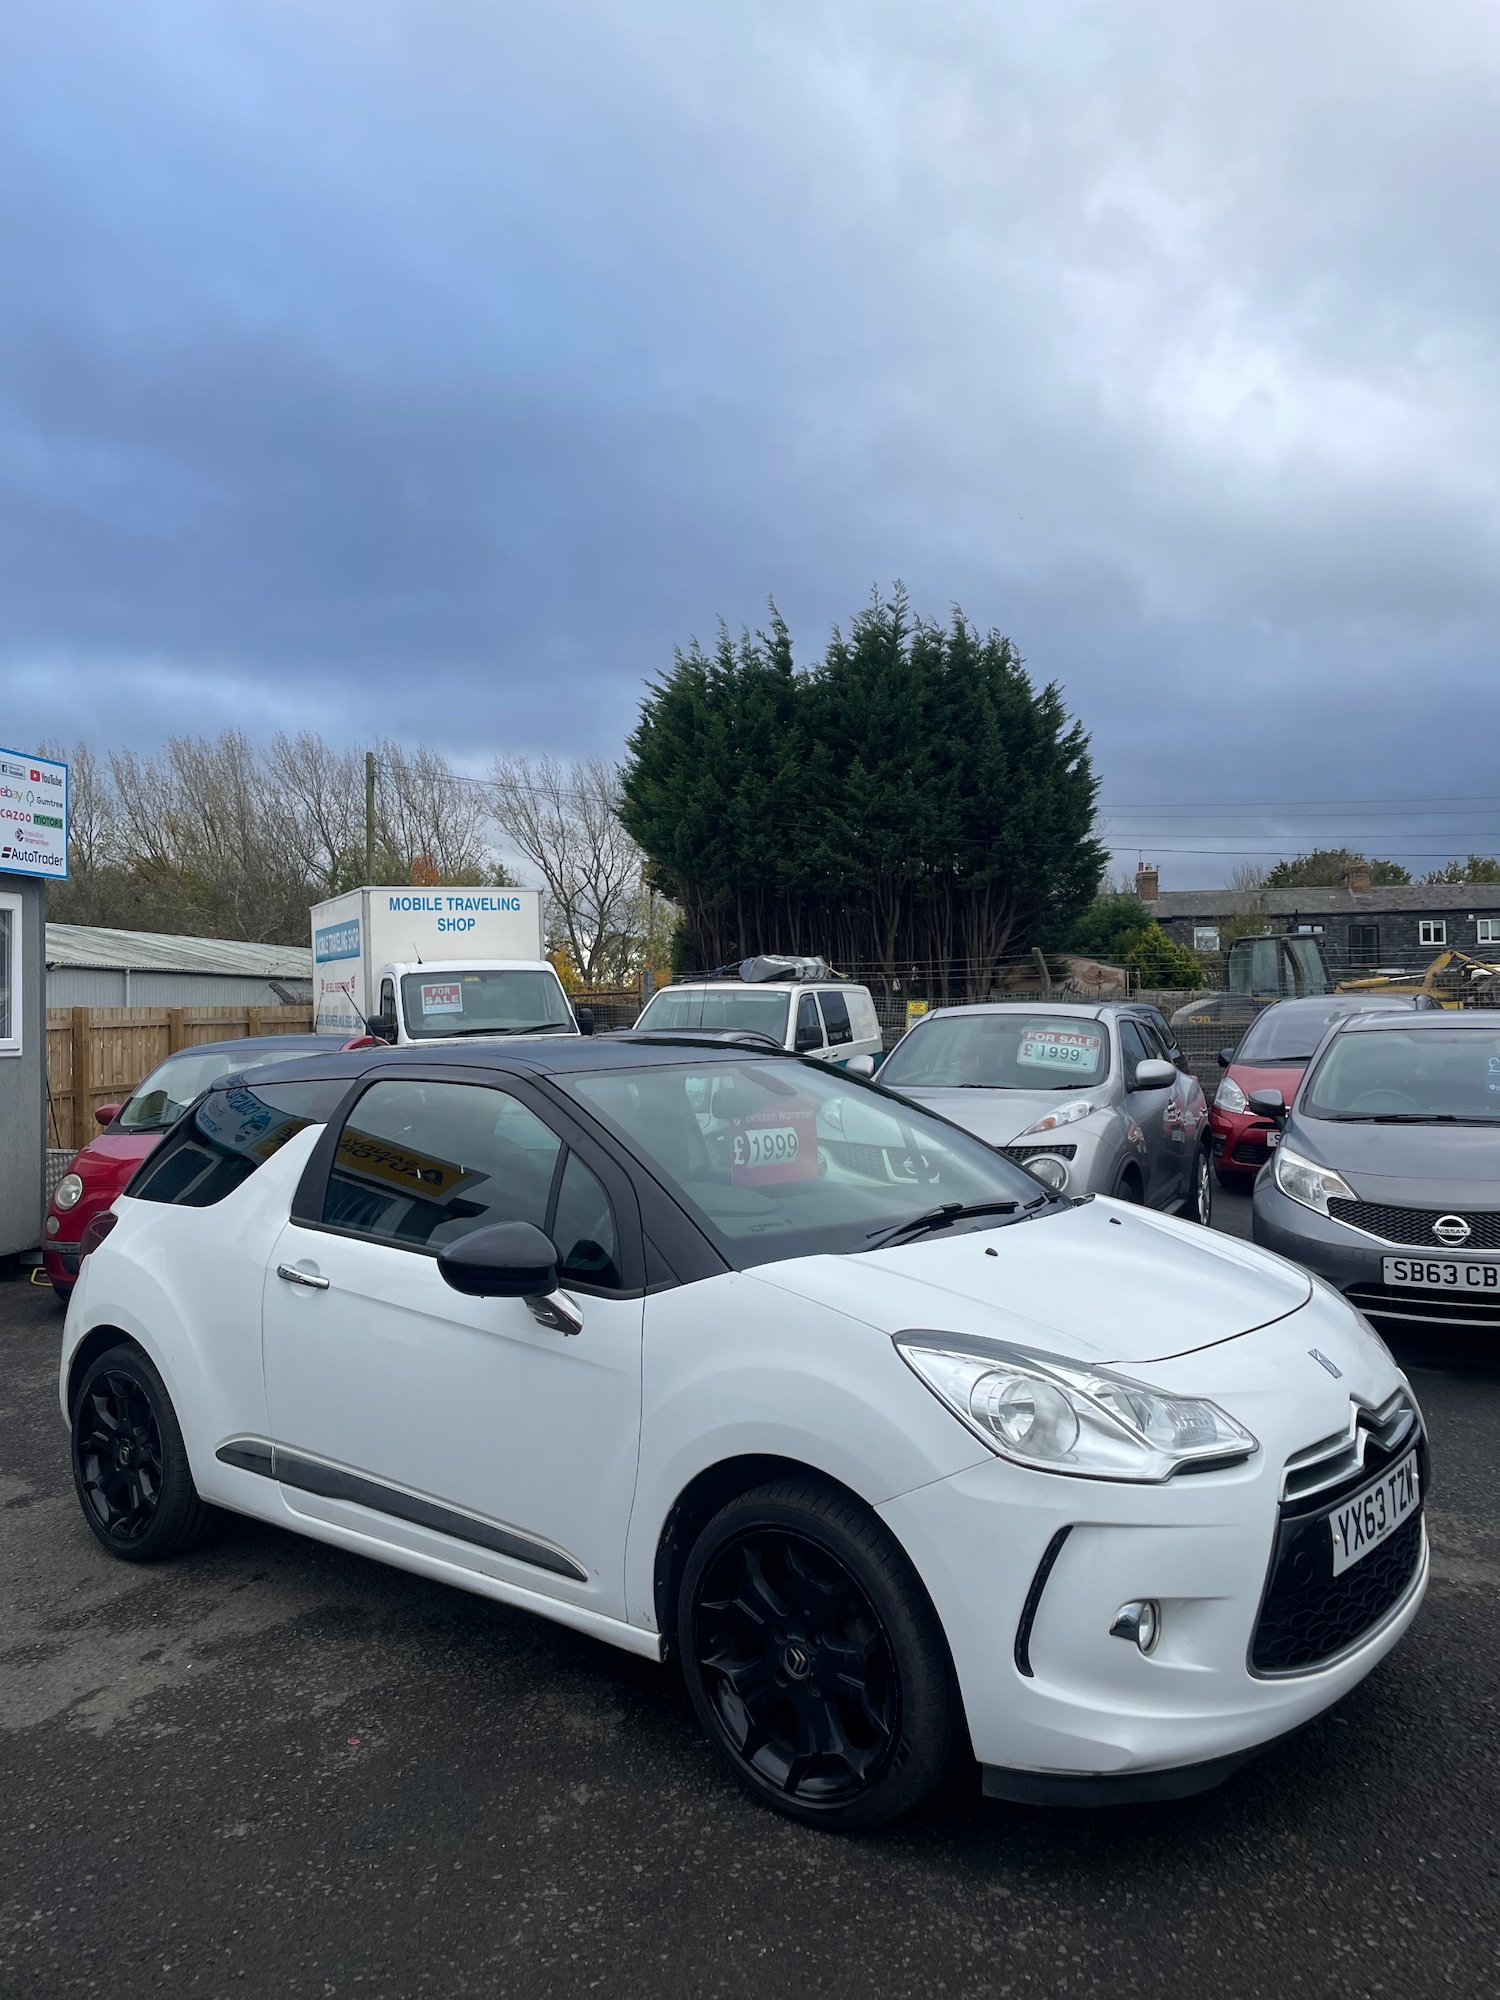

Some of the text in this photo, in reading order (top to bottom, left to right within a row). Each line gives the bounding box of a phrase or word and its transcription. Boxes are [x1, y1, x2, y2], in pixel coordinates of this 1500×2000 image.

[41, 772, 63, 787] YouTube
[36, 796, 63, 809] Gumtree
[0, 808, 32, 823] CAZOO
[11, 847, 64, 867] AutoTrader
[389, 897, 521, 911] MOBILE TRAVELING
[437, 918, 476, 932] SHOP
[431, 987, 451, 996] FOR
[425, 994, 459, 1005] SALE
[1027, 1032, 1096, 1047] FOR SALE
[746, 1112, 777, 1123] Evolution
[1436, 1227, 1468, 1235] NISSAN
[1393, 1260, 1458, 1286] SB63
[1338, 1486, 1386, 1558] YX63
